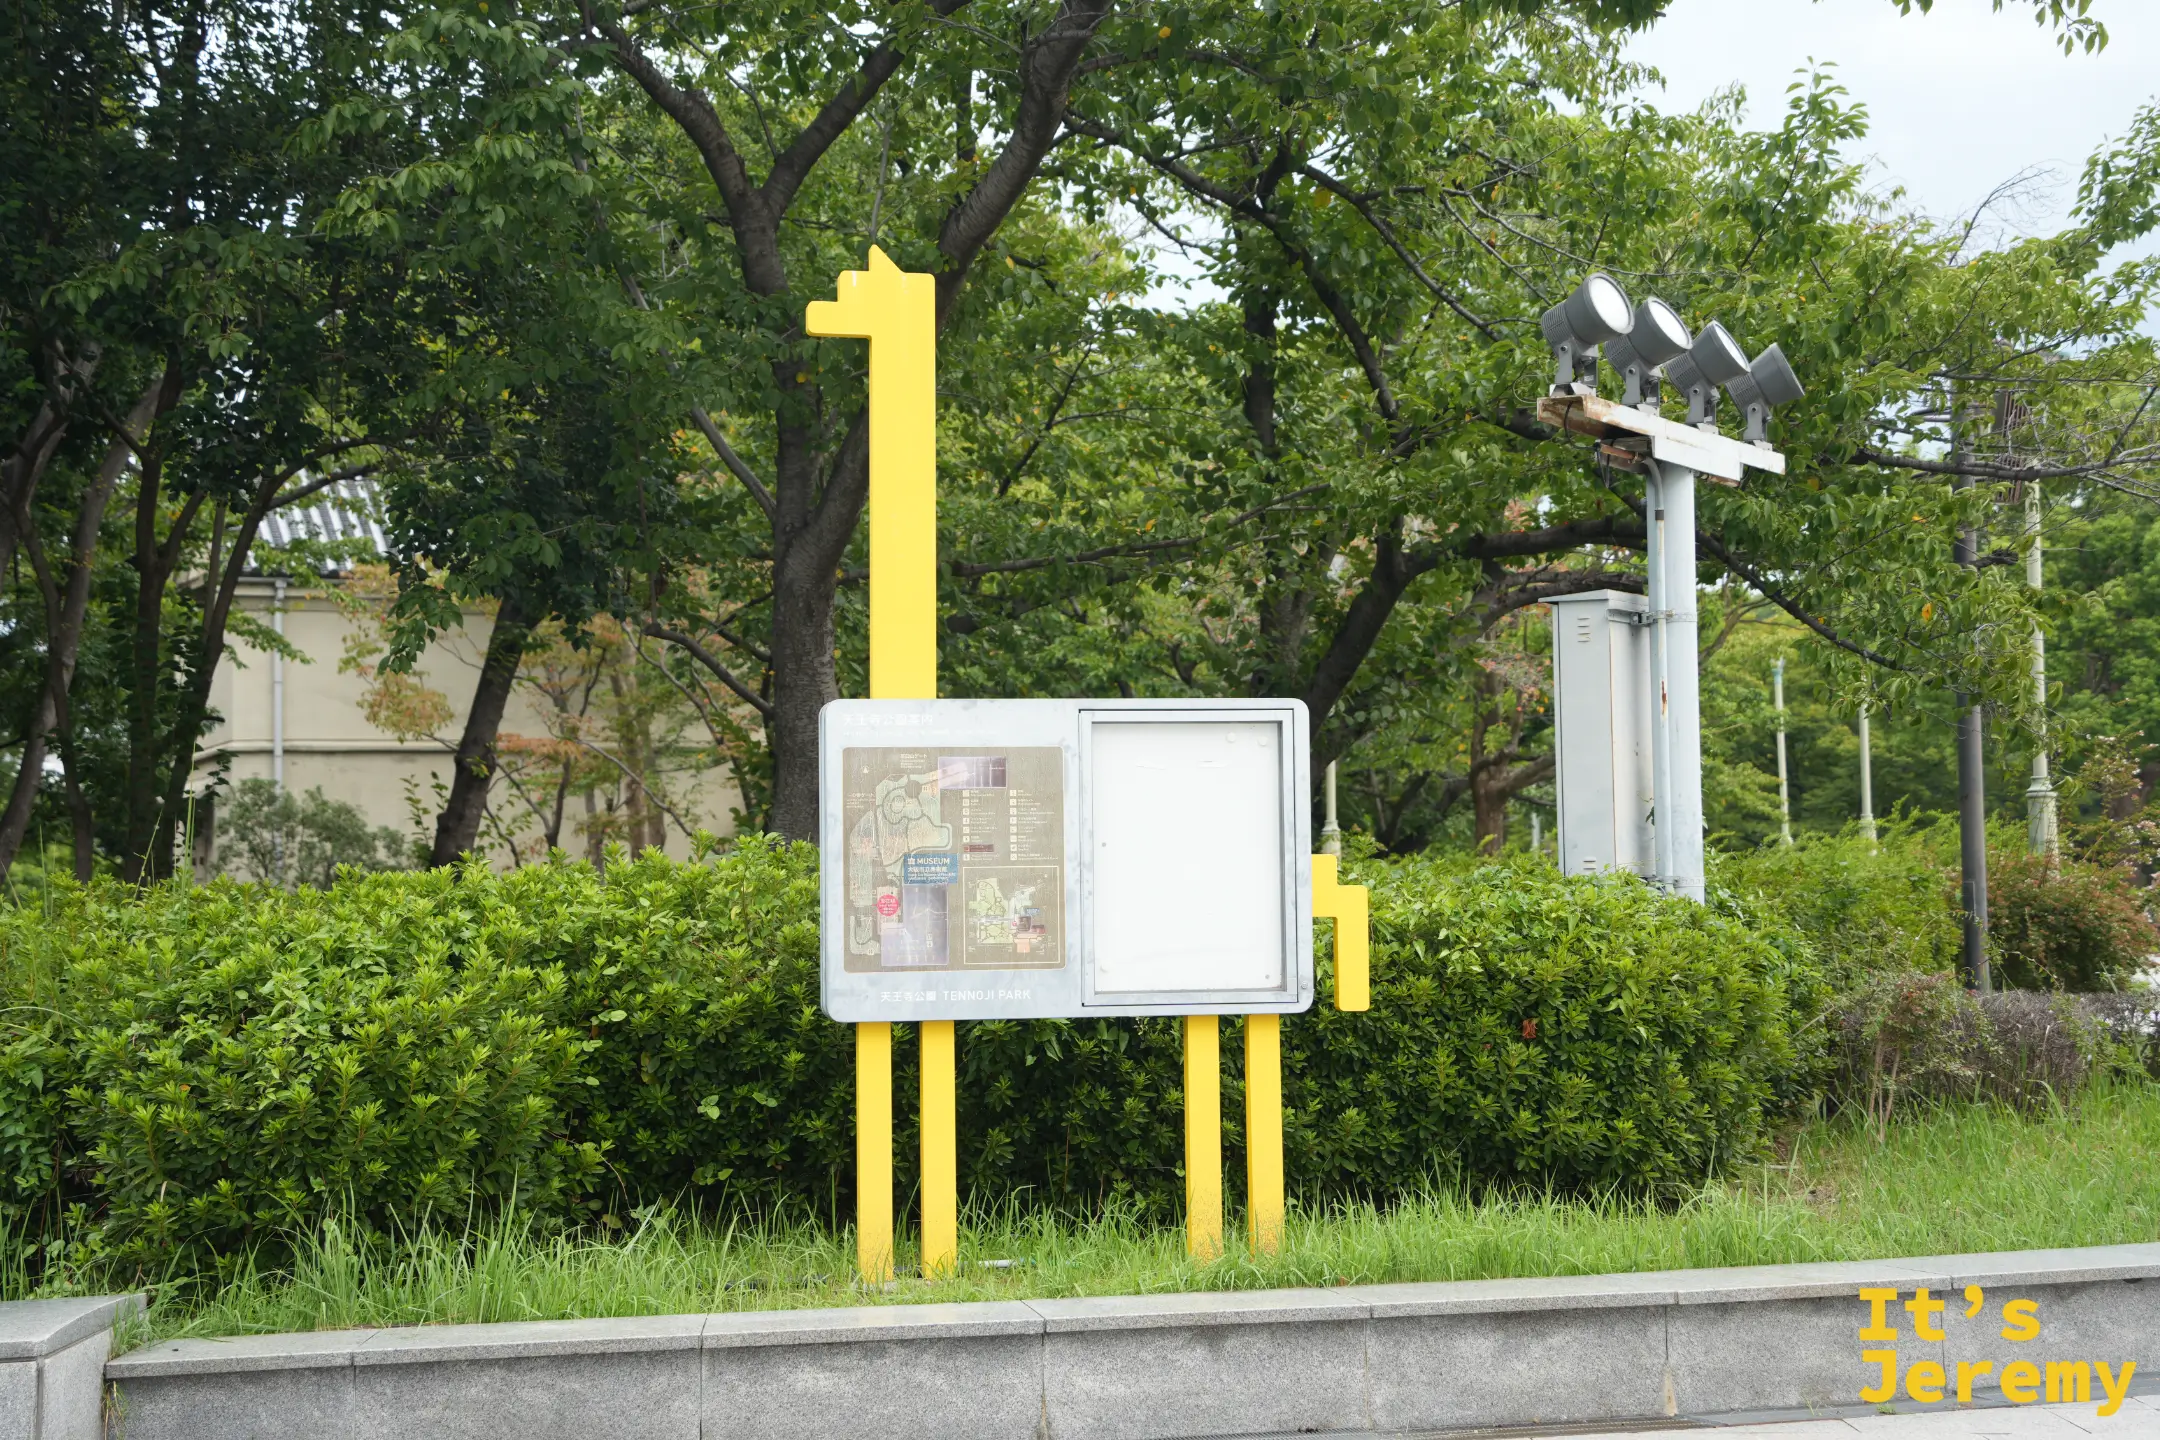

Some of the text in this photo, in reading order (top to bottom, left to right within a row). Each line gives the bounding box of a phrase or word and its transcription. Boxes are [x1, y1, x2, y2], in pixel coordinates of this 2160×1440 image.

[917, 857, 950, 865] MUSEUM
[880, 989, 1032, 1002] 天王寺公園 TENNOJI PARK
